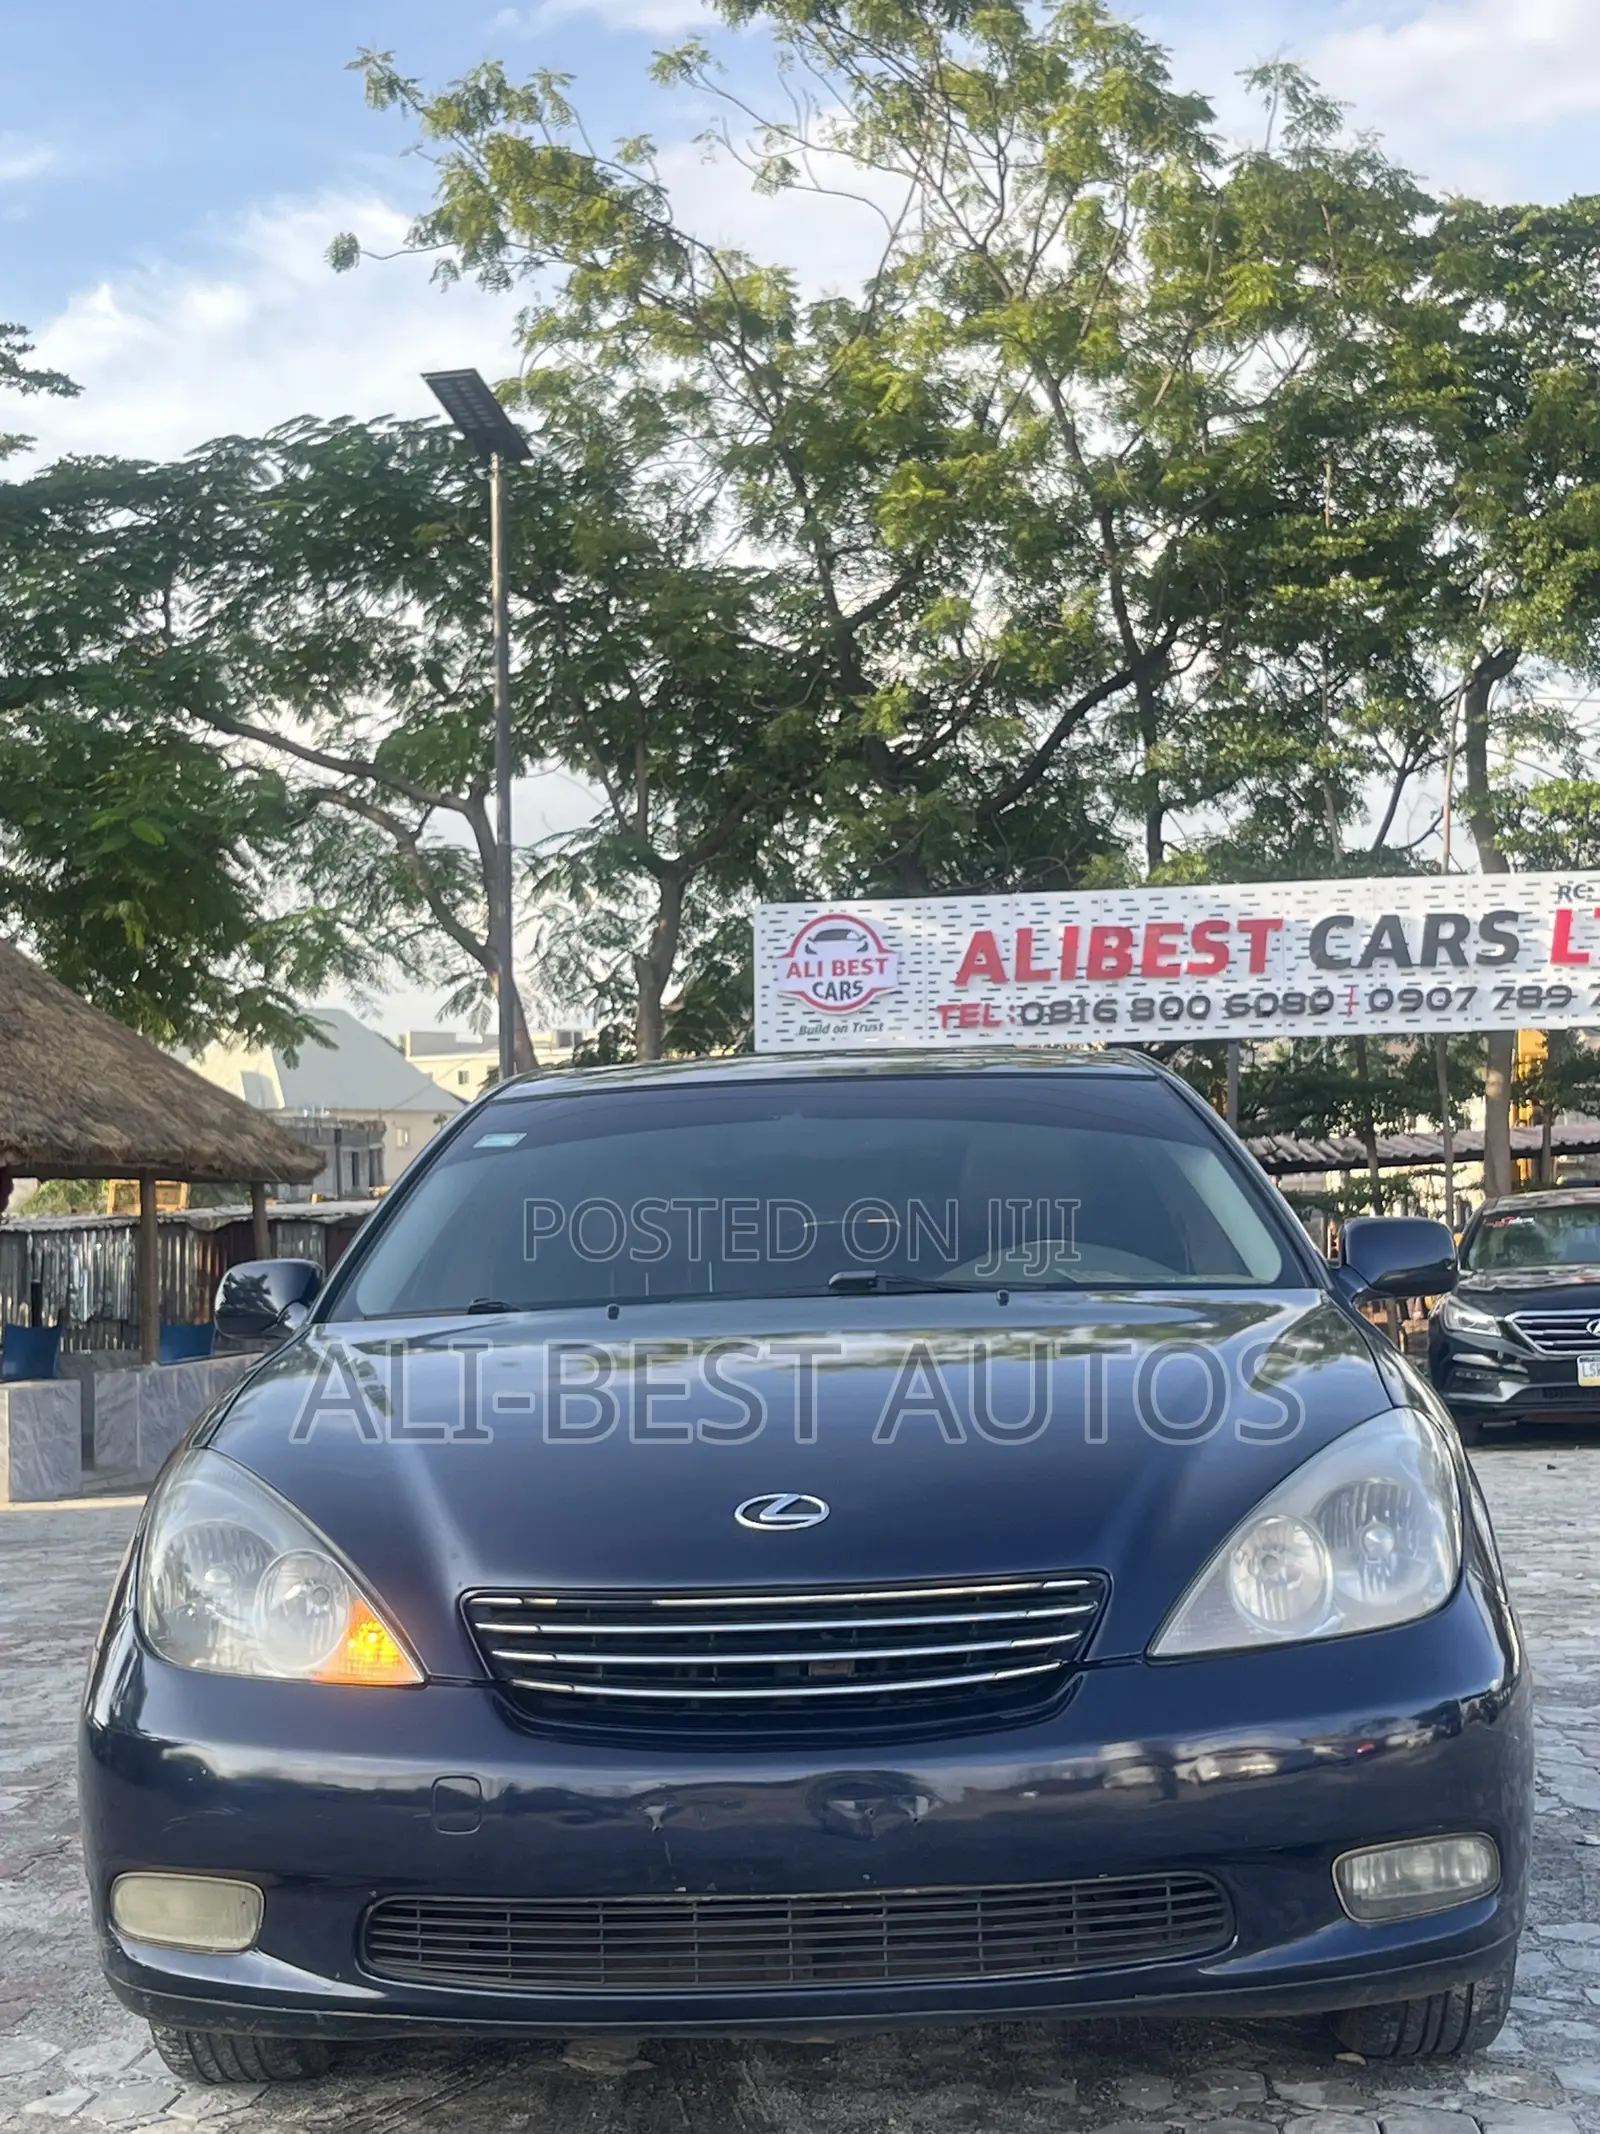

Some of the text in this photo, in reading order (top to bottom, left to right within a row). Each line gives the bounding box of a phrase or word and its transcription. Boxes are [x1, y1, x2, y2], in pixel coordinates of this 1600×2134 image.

[954, 908, 1600, 986] ALIBEST CARS L
[787, 958, 888, 979] ALI BEST
[812, 980, 863, 1001] CARS
[1130, 994, 1212, 1021] 800
[1367, 986, 1478, 1012] 0907
[1492, 985, 1573, 1010] 789
[799, 1021, 885, 1036] Build on Trust
